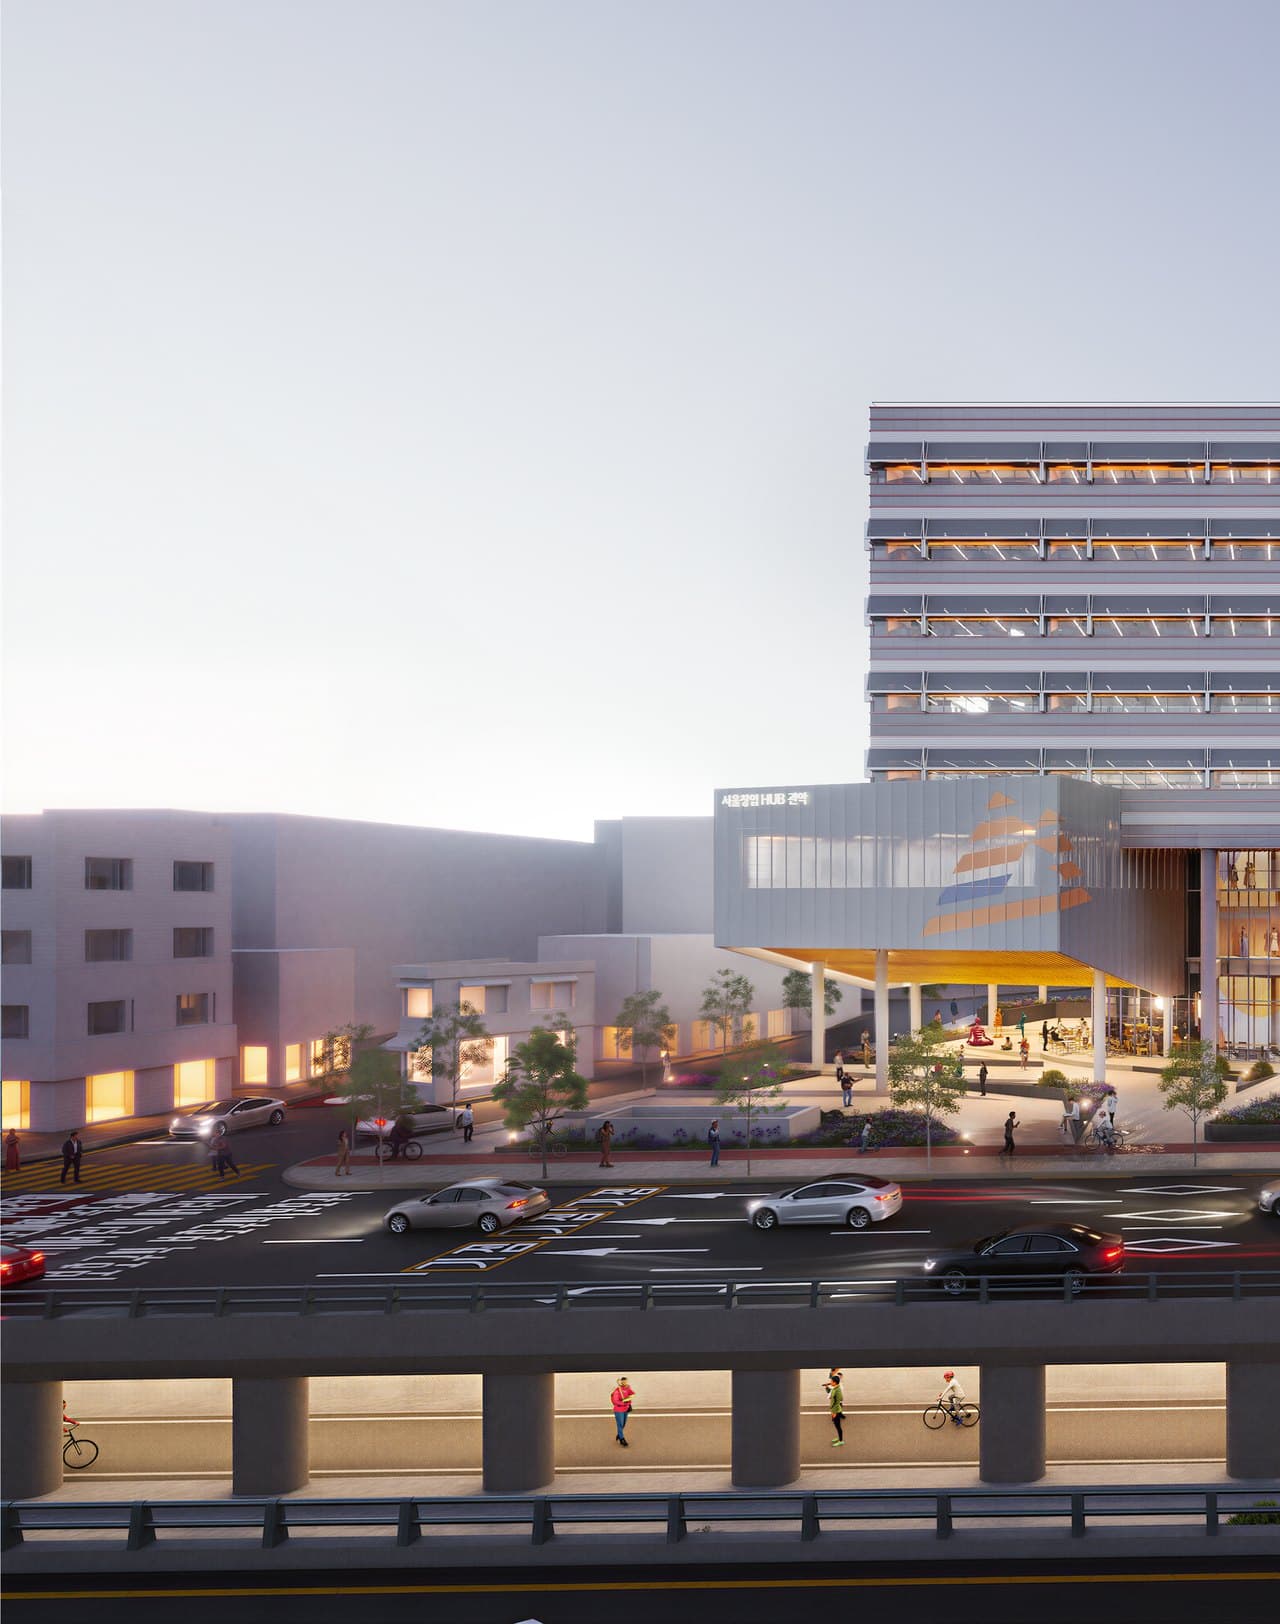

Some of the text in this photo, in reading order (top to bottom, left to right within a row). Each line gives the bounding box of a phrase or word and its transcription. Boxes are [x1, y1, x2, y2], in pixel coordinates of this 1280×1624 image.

[721, 791, 809, 807] 서울창업 HUB 관악
[243, 1191, 375, 1214] 보호구역
[146, 1216, 296, 1243] 보호구역
